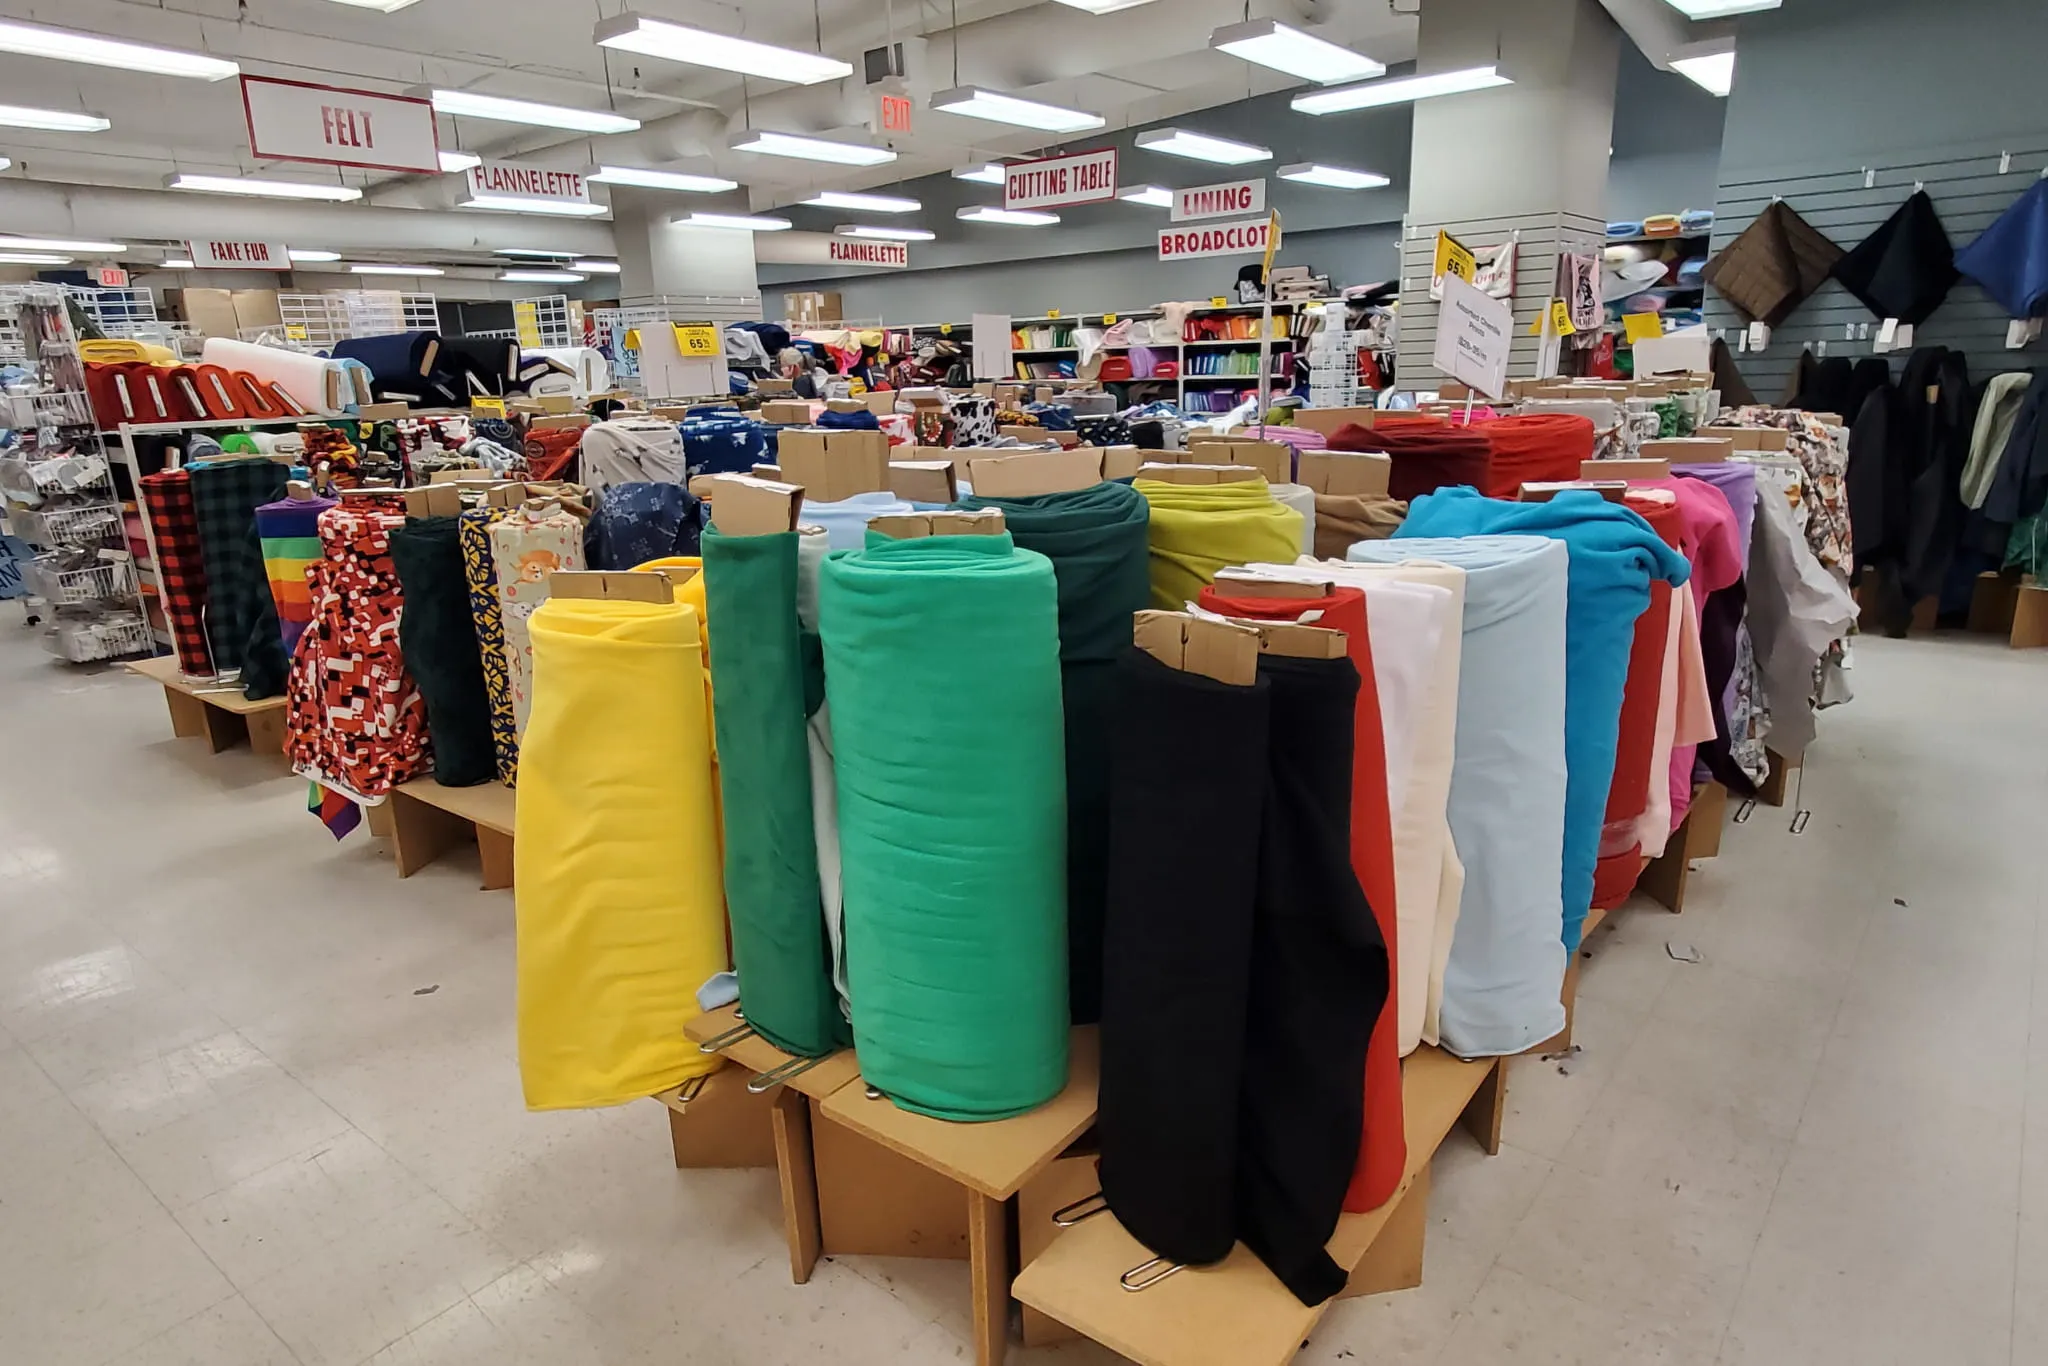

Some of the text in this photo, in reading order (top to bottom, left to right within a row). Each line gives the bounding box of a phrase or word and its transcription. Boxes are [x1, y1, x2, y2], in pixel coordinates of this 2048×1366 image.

[321, 105, 373, 149] FELT
[881, 96, 911, 132] EXIT
[473, 166, 582, 197] FLANNELETTE
[1009, 160, 1111, 200] CUTTING TABLE
[1184, 186, 1251, 215] LINING
[210, 242, 270, 261] FAKE FUR
[830, 241, 905, 263] FLANNELETTE
[1161, 225, 1270, 255] BROADCLOT
